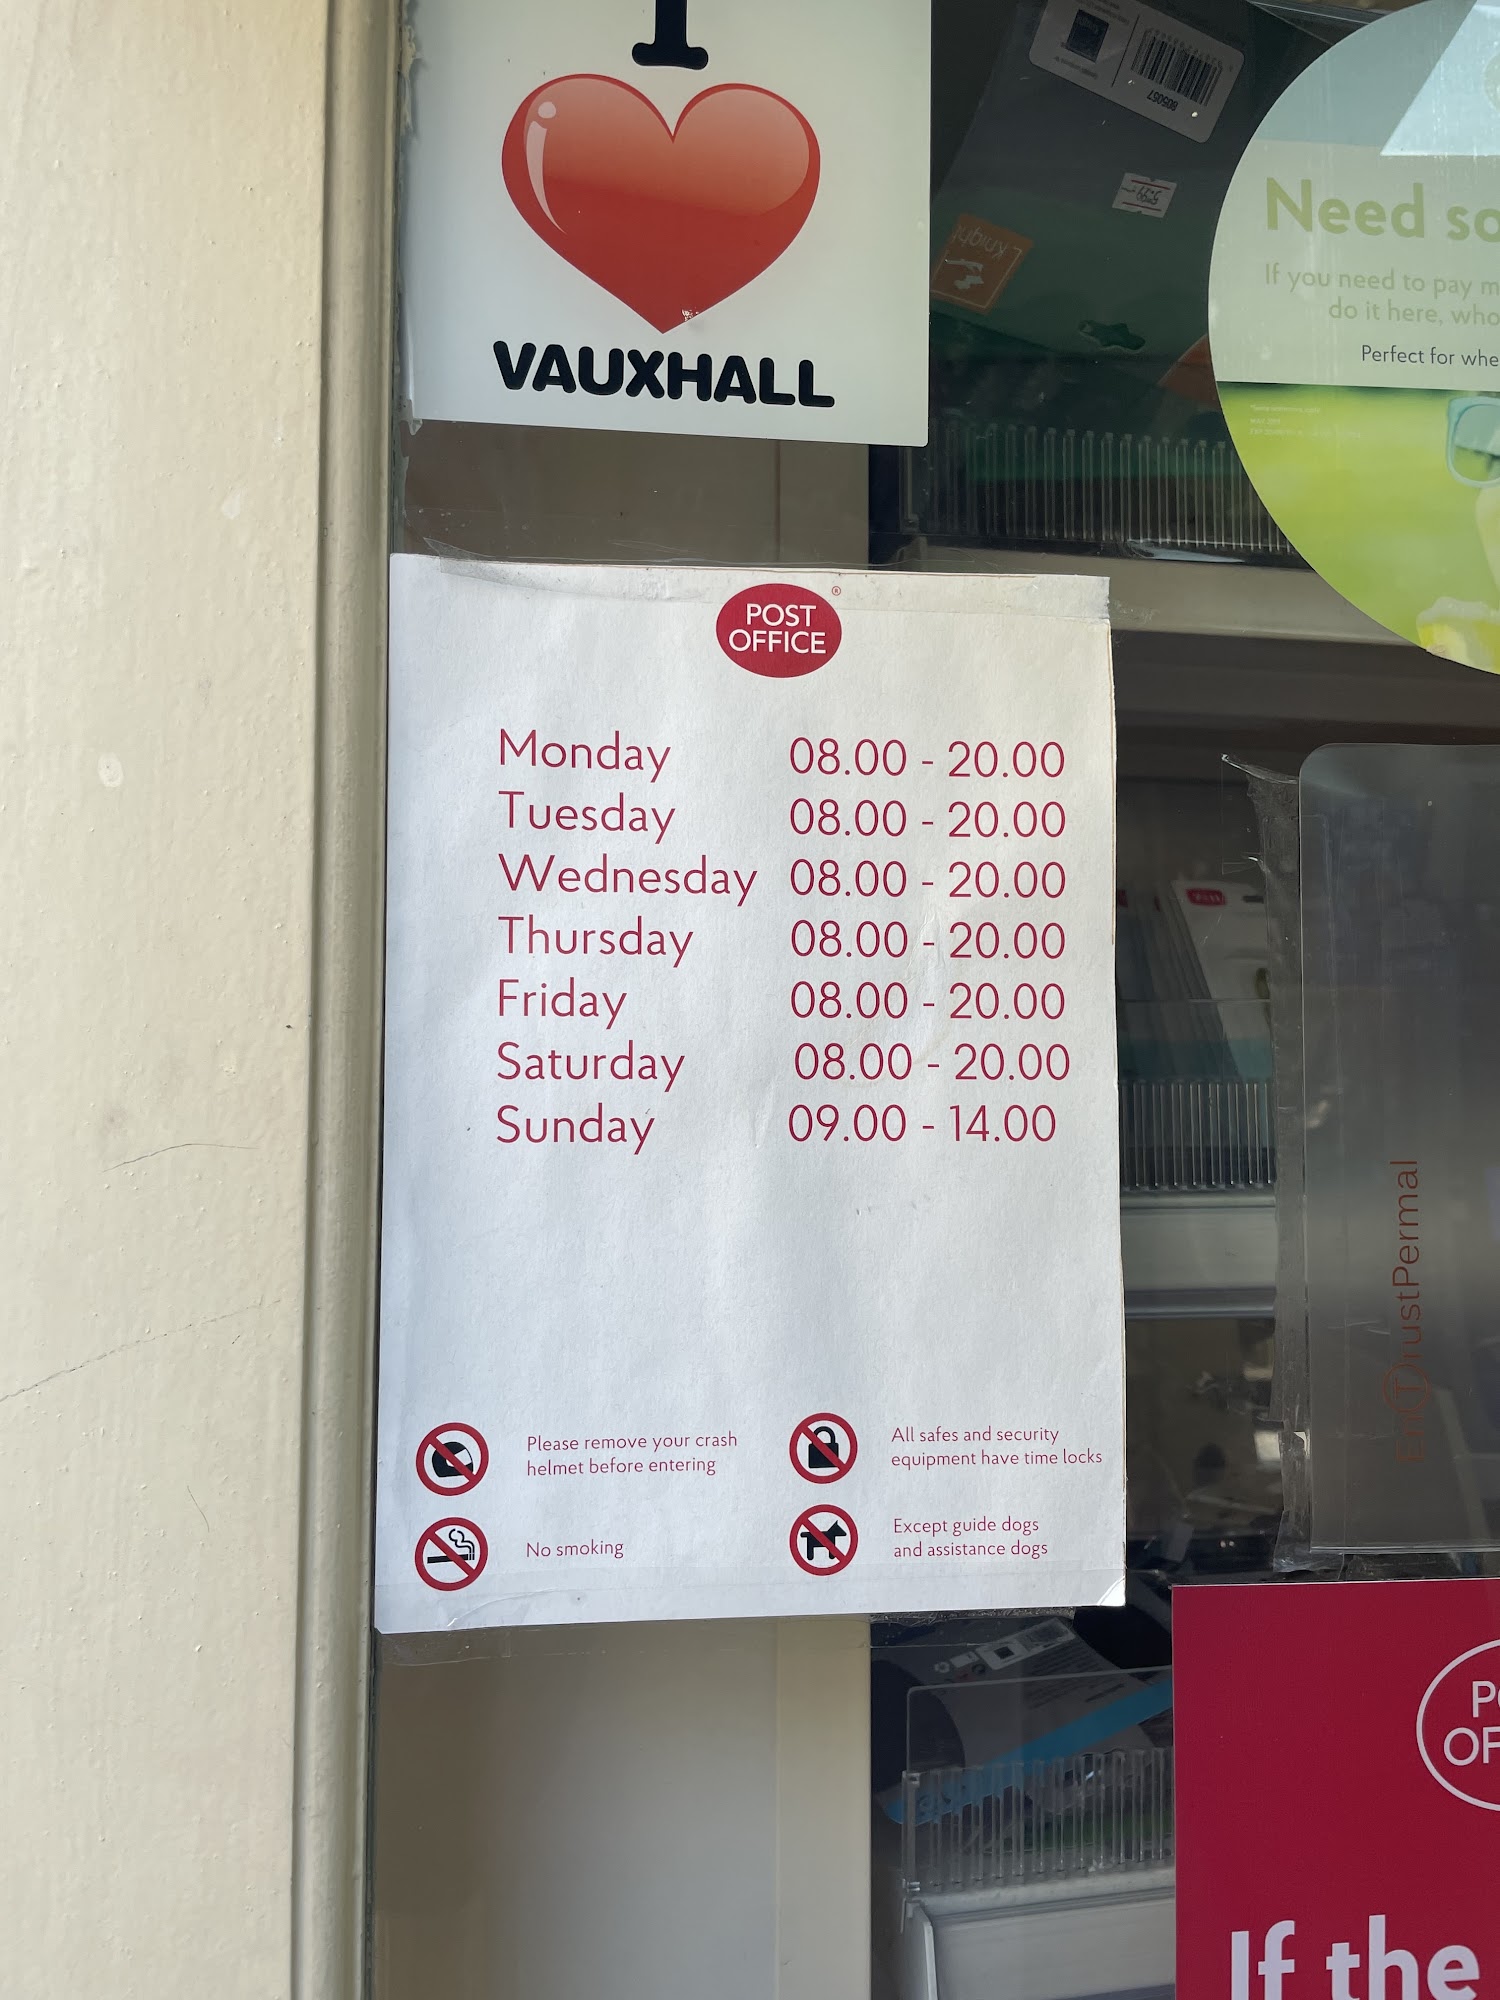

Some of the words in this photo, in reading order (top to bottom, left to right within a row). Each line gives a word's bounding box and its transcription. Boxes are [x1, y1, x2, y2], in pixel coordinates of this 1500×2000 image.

[1266, 177, 1425, 239] Need
[1447, 206, 1500, 243] so
[1265, 262, 1280, 285] If
[1287, 271, 1330, 293] you
[1338, 268, 1395, 290] need
[1403, 274, 1425, 292] to
[1433, 278, 1472, 301] pay
[1328, 296, 1358, 320] do
[1366, 301, 1380, 321] it
[1388, 299, 1444, 326] here,
[1450, 303, 1500, 326] who
[493, 340, 835, 408] VAUXHALL
[1361, 344, 1425, 364] Perfect
[1430, 347, 1455, 365] for
[1461, 349, 1499, 367] whe
[746, 603, 817, 627] POST
[728, 628, 827, 654] OFFICE
[500, 729, 670, 783] Monday
[789, 737, 907, 776] 08.00
[948, 741, 1065, 778] 20.00
[498, 790, 675, 845] Tuesday
[790, 798, 907, 837] 08.00
[948, 801, 1066, 838] 20.00
[499, 853, 757, 907] Wednesday
[790, 858, 907, 898] 08.00
[949, 861, 1066, 899] 20.00
[498, 914, 693, 968] Thursday
[791, 919, 908, 958] 08.00
[949, 921, 1065, 960] 20.00
[499, 977, 626, 1030] Friday
[791, 981, 908, 1019] 08.00
[949, 982, 1065, 1020] 20.00
[498, 1040, 685, 1092] Saturday
[794, 1042, 912, 1080] 08.00
[954, 1043, 1070, 1081] 20.00
[497, 1102, 654, 1155] Sunday
[788, 1104, 907, 1142] 09.00
[950, 1104, 1056, 1142] 14.00
[527, 1435, 580, 1452] Please
[584, 1436, 648, 1450] remove
[652, 1435, 691, 1453] your
[695, 1431, 738, 1448] crash
[891, 1427, 915, 1443] All
[919, 1427, 959, 1442] safes
[963, 1427, 992, 1441] and
[996, 1427, 1060, 1445] security
[527, 1460, 585, 1477] helmet
[589, 1458, 644, 1475] before
[649, 1458, 717, 1476] entering
[891, 1451, 976, 1471] equipment
[981, 1449, 1019, 1465] have
[1024, 1449, 1058, 1465] time
[1063, 1448, 1103, 1464] locks
[894, 1518, 948, 1535] Except
[952, 1517, 997, 1537] guide
[1001, 1516, 1040, 1534] dogs
[526, 1542, 552, 1558] No
[556, 1540, 624, 1559] smoking
[894, 1541, 923, 1558] and
[927, 1541, 1006, 1557] assistance
[1010, 1540, 1048, 1560] dogs
[1472, 1680, 1500, 1718] P
[1231, 1920, 1295, 2000] If
[1326, 1914, 1480, 2000] the
